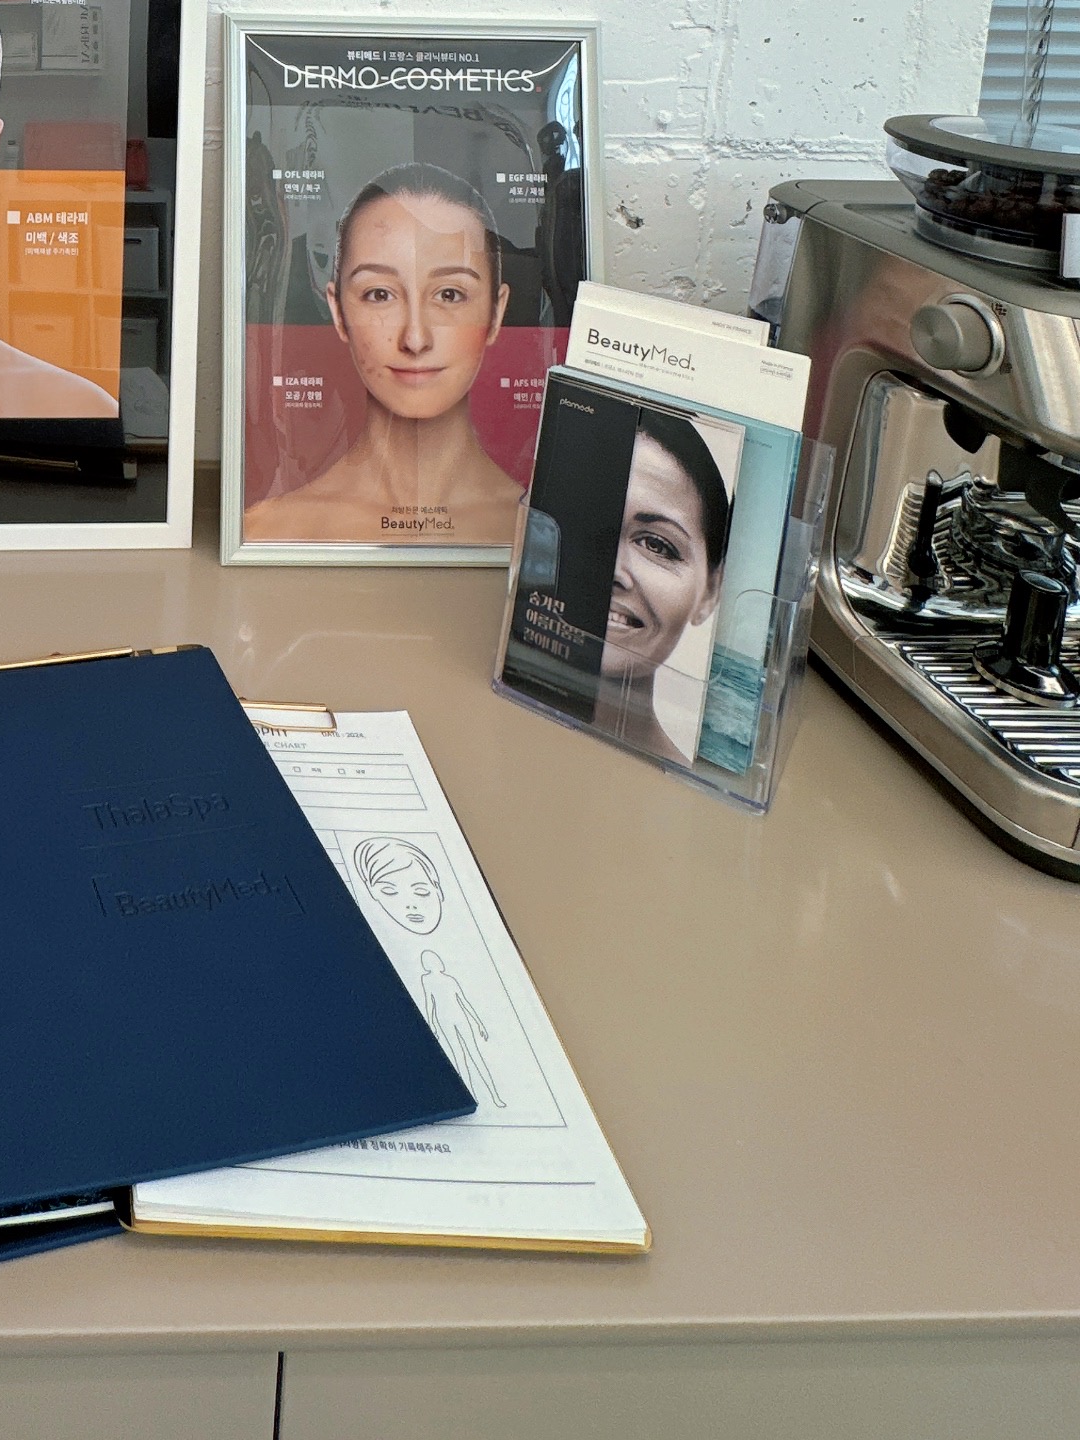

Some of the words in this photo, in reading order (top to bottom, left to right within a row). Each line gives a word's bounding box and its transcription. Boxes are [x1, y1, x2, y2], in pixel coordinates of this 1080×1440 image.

[346, 50, 381, 61] 뷰티메드
[388, 51, 414, 62] 프랑스
[416, 52, 457, 63] 클리닉뷰티
[459, 53, 480, 63] NO.1
[284, 170, 301, 179] OFL
[509, 173, 524, 182] EGF
[26, 212, 53, 224] ABM
[56, 212, 88, 225] 테라피
[26, 231, 47, 244] 미백
[58, 231, 79, 244] 색조
[274, 741, 307, 750] CHART
[81, 792, 230, 830] ThalaSpa
[370, 1141, 397, 1152] 정확히
[399, 1141, 452, 1154] 기록해주세요
